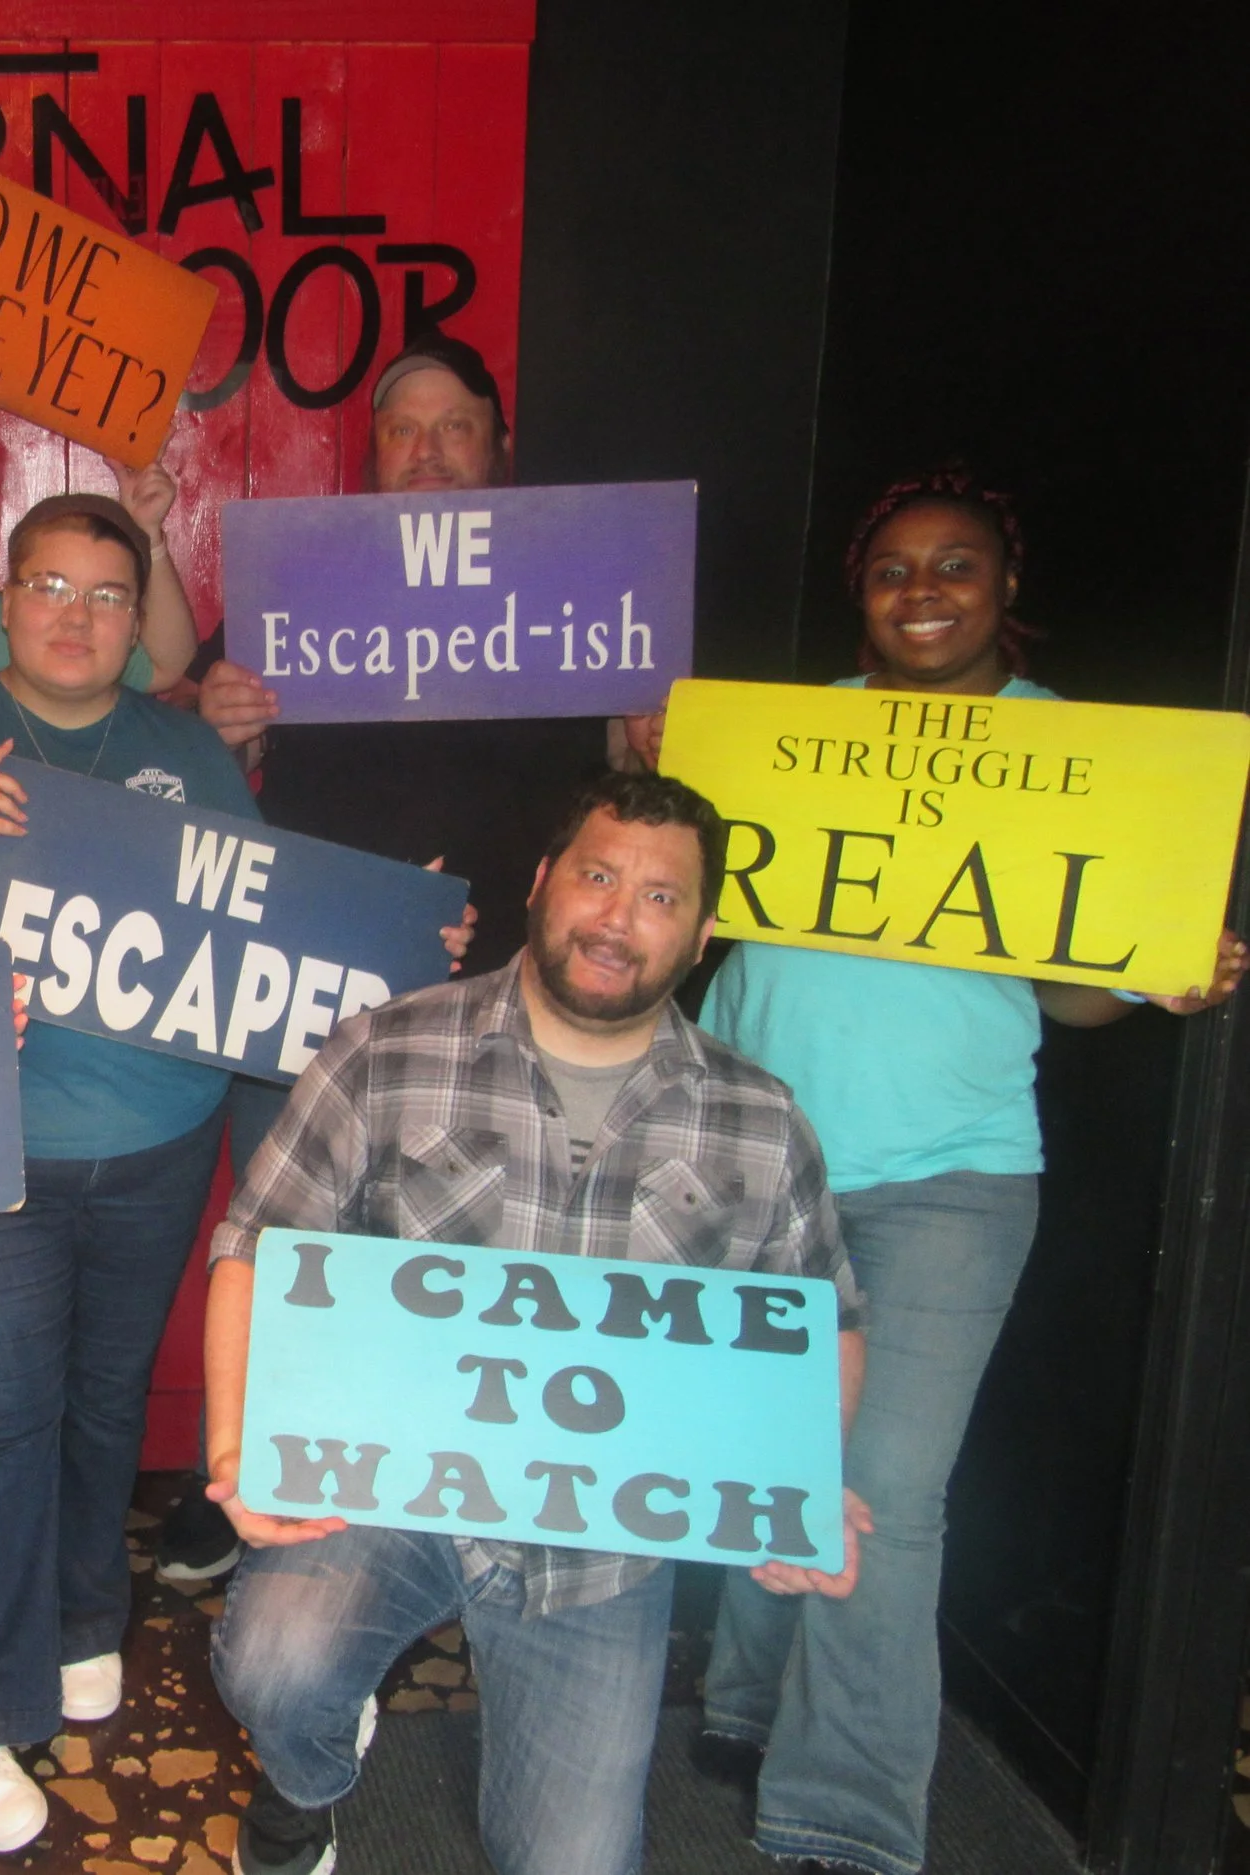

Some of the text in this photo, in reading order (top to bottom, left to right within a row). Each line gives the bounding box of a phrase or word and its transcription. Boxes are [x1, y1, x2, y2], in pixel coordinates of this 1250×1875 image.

[16, 211, 120, 327] WE
[27, 316, 167, 443] YET?
[400, 511, 492, 587] WE
[261, 591, 655, 700] Escaped-ish
[772, 735, 1093, 796] STRUGGLE
[879, 700, 993, 741] THE
[897, 789, 945, 828] IS
[176, 824, 276, 923] WE
[715, 818, 1137, 973] REAL
[283, 1243, 810, 1355] I CAME
[456, 1354, 626, 1435] TO
[269, 1434, 819, 1558] WATCH
